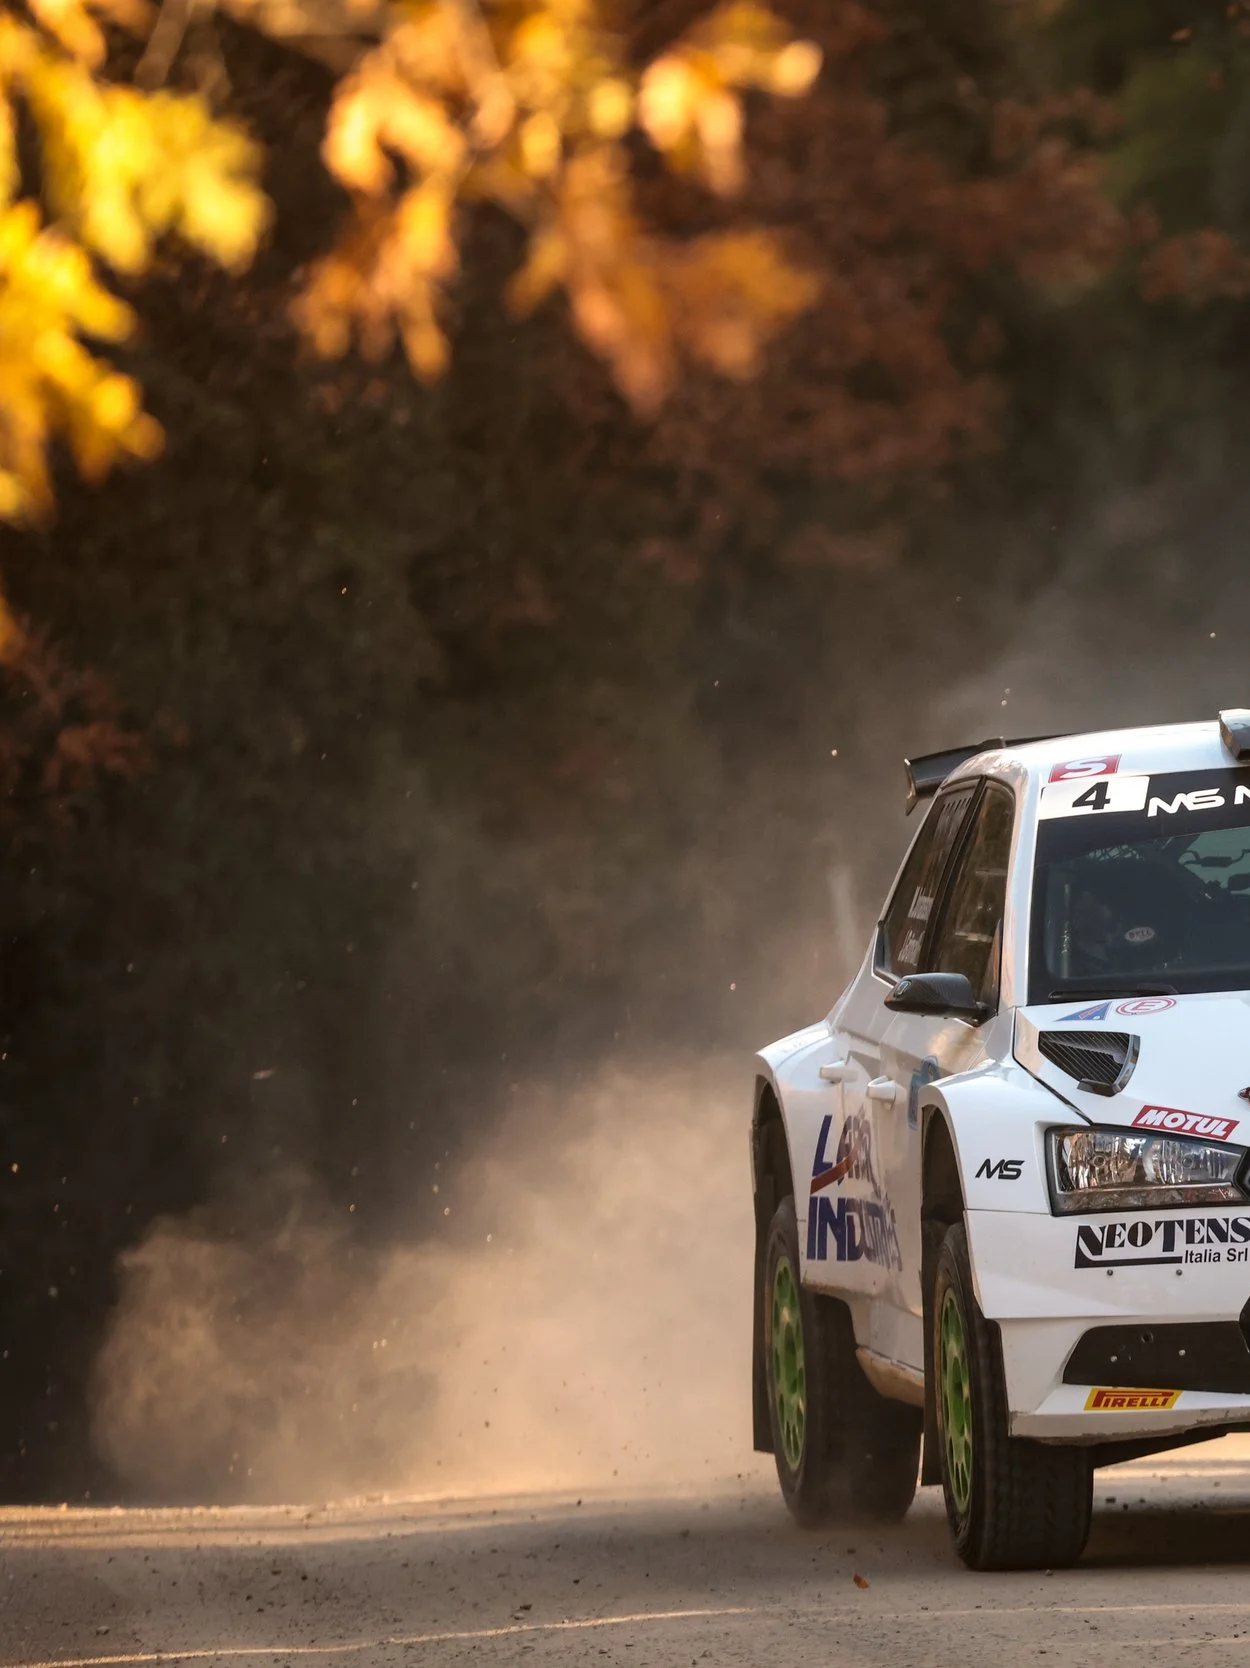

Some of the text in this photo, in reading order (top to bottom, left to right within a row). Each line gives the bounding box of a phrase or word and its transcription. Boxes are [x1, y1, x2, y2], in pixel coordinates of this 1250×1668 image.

[1072, 781, 1111, 810] 4
[1148, 788, 1225, 817] MS
[1140, 1108, 1233, 1137] MOTUL
[975, 1158, 1025, 1180] MS
[1185, 1247, 1248, 1264] Italia Srl
[1092, 1390, 1174, 1408] PIRELLI
